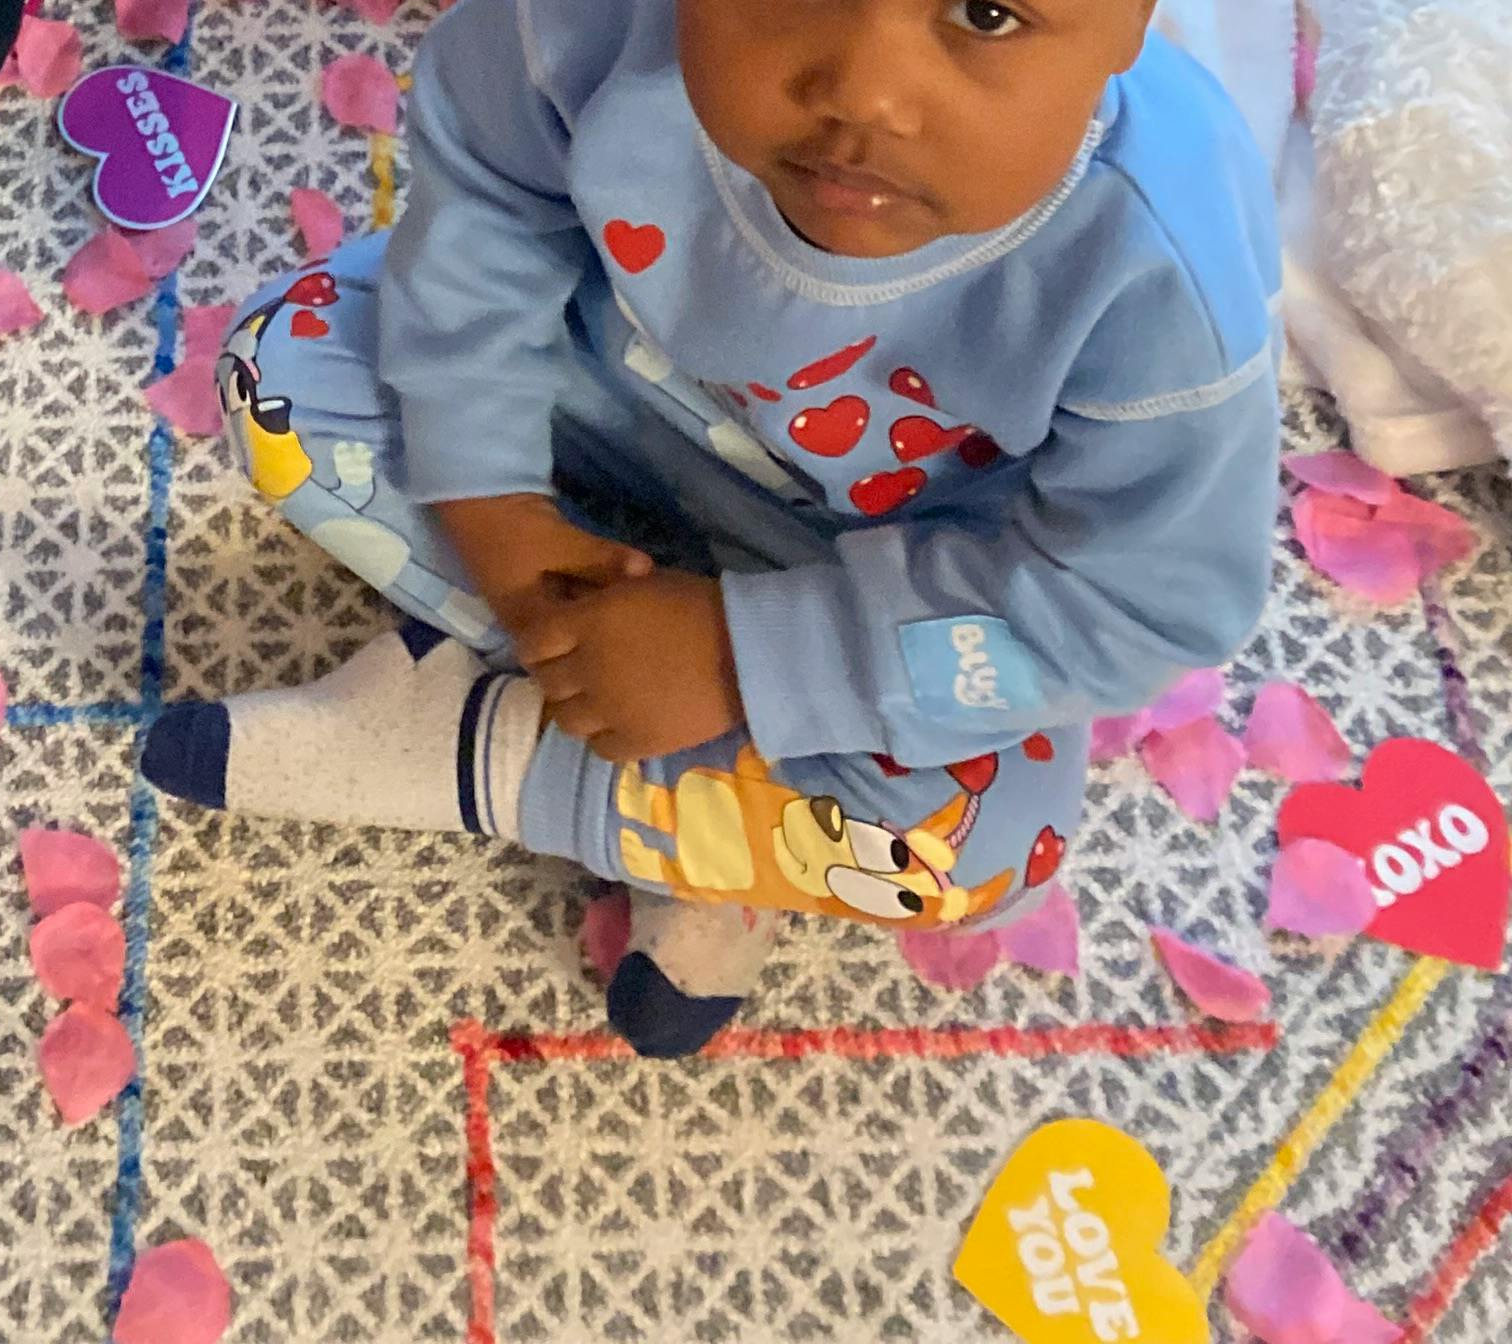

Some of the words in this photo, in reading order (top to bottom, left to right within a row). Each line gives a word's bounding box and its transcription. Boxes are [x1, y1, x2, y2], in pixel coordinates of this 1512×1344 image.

[115, 70, 199, 199] KISSES
[1007, 1195, 1081, 1317] YOU
[1048, 1167, 1141, 1343] LOVE
